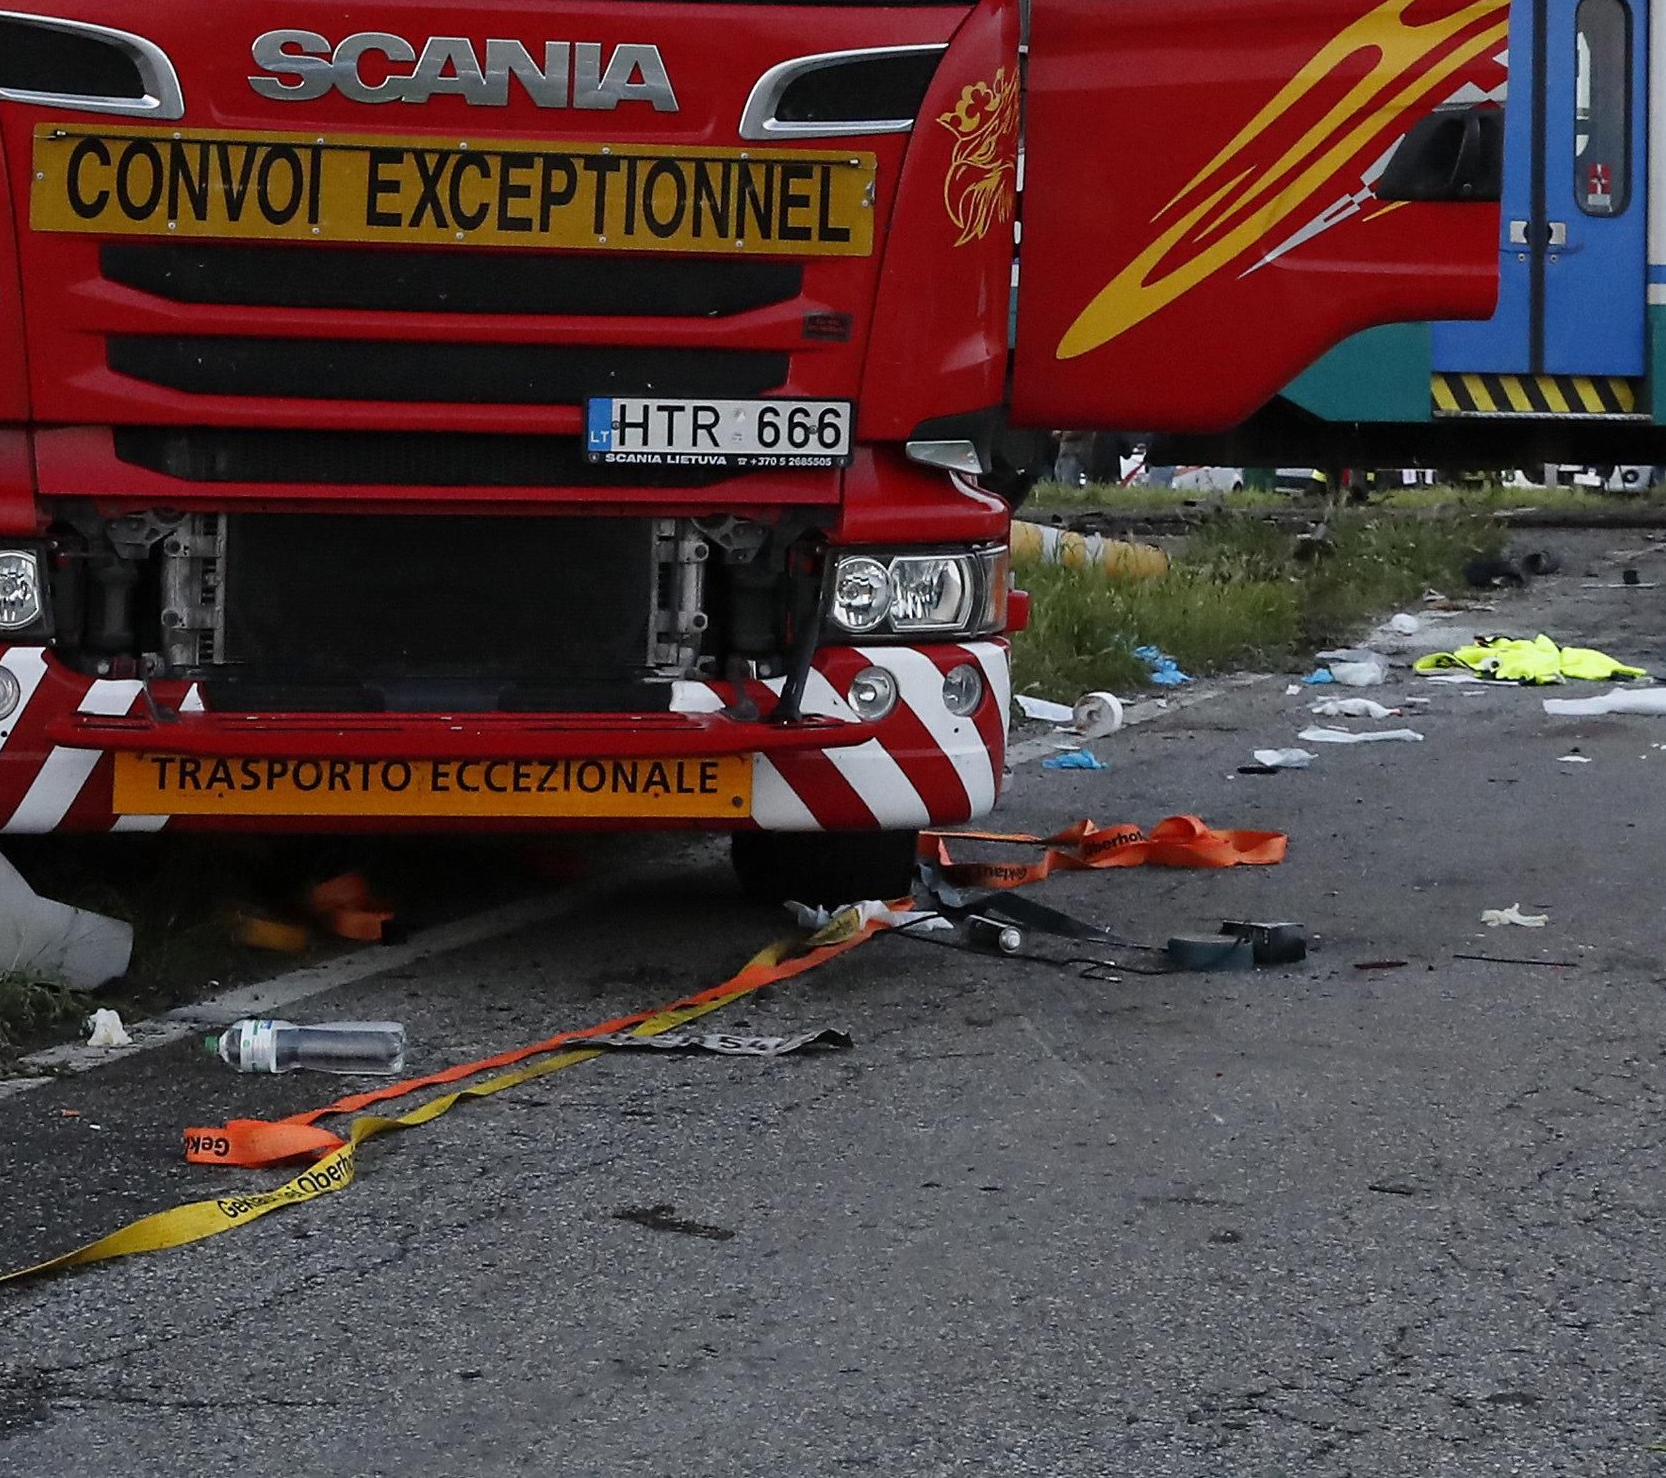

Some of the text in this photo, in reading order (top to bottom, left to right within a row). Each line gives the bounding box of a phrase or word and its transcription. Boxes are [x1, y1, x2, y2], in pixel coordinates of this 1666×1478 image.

[247, 28, 681, 112] SCANIA
[66, 136, 851, 243] CONVOI EXCEPTIONNEL
[590, 403, 842, 450] LT HTR 666
[604, 452, 663, 465] SCANIA
[666, 454, 728, 466] LIETUVA
[749, 456, 778, 467] +370
[151, 757, 720, 795] TRASPORTO ECCEZIONALE
